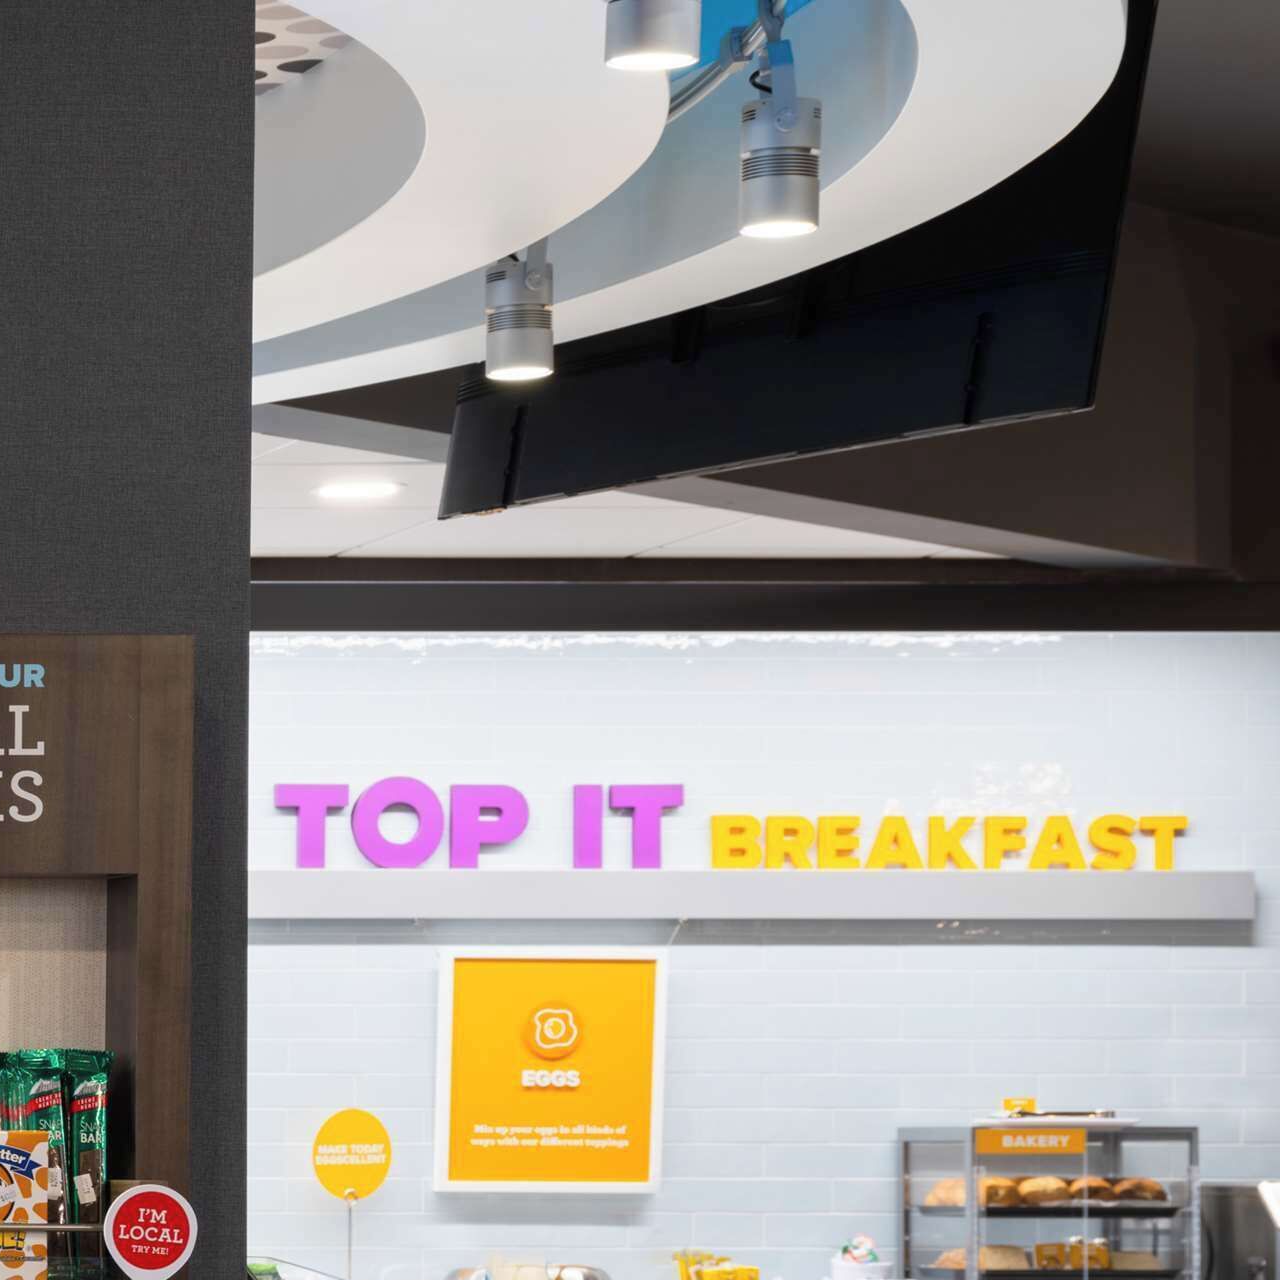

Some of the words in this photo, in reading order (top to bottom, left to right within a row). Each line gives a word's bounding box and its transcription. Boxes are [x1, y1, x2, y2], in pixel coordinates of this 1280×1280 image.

[273, 776, 530, 869] TOP
[572, 784, 685, 869] IT
[710, 813, 1189, 870] BREAKFAST
[520, 1069, 581, 1087] EGGS
[80, 1132, 103, 1144] BAR
[1002, 1135, 1071, 1148] BAKERY
[137, 1207, 168, 1226] I'M
[117, 1224, 185, 1245] LOCAL
[130, 1244, 151, 1256] TRY
[151, 1245, 170, 1257] ME!
